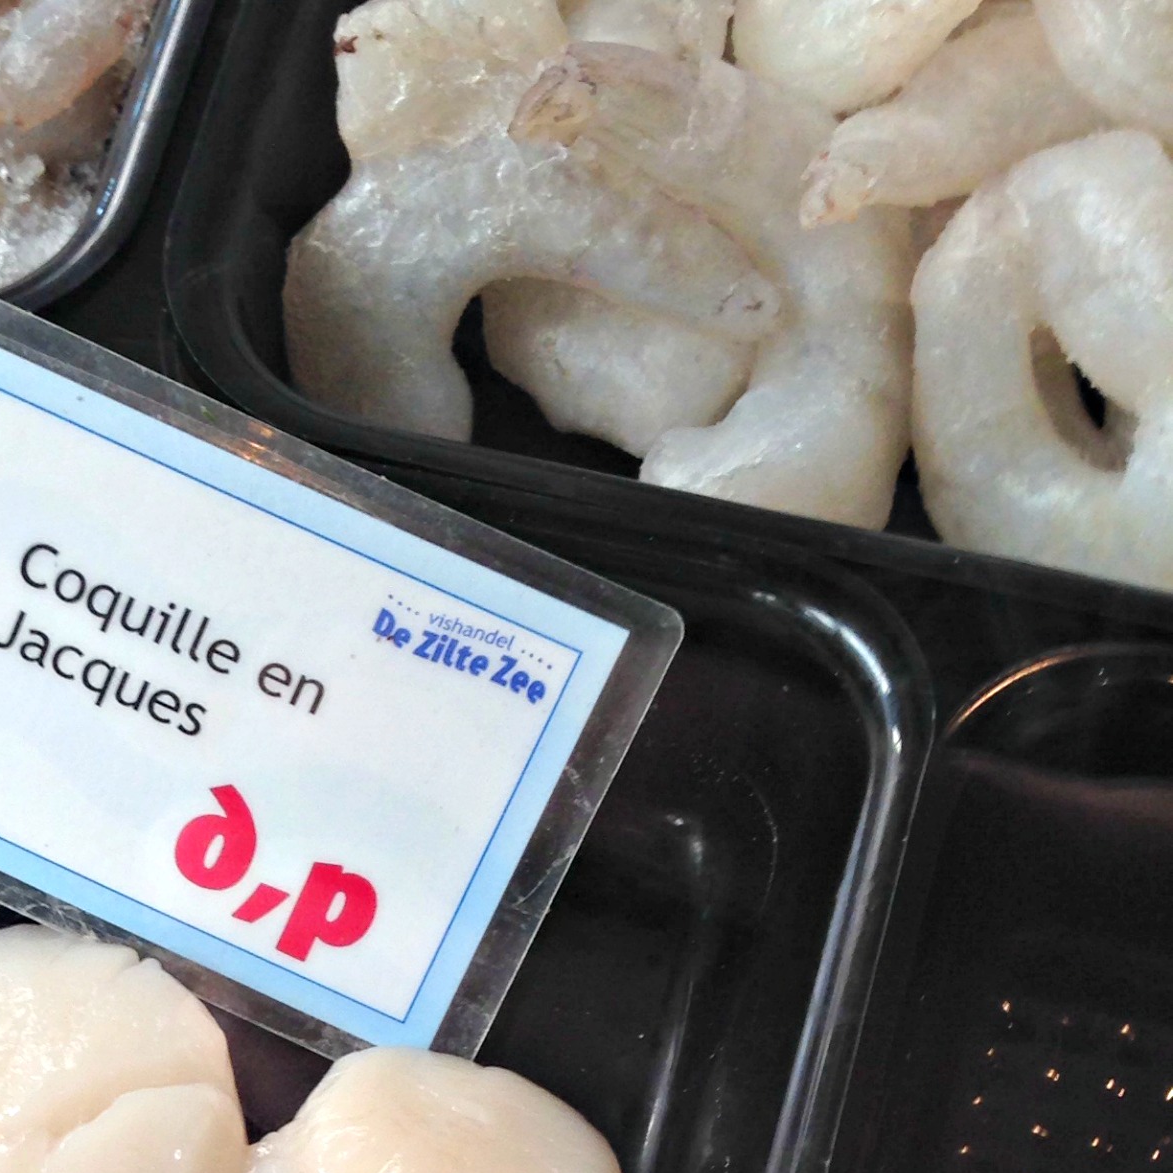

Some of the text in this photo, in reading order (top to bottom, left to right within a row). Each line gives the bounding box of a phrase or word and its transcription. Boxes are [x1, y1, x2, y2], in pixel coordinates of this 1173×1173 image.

[20, 543, 325, 716] Coquille en
[371, 606, 547, 705] De Zilte Zee
[428, 612, 515, 651] vishandel
